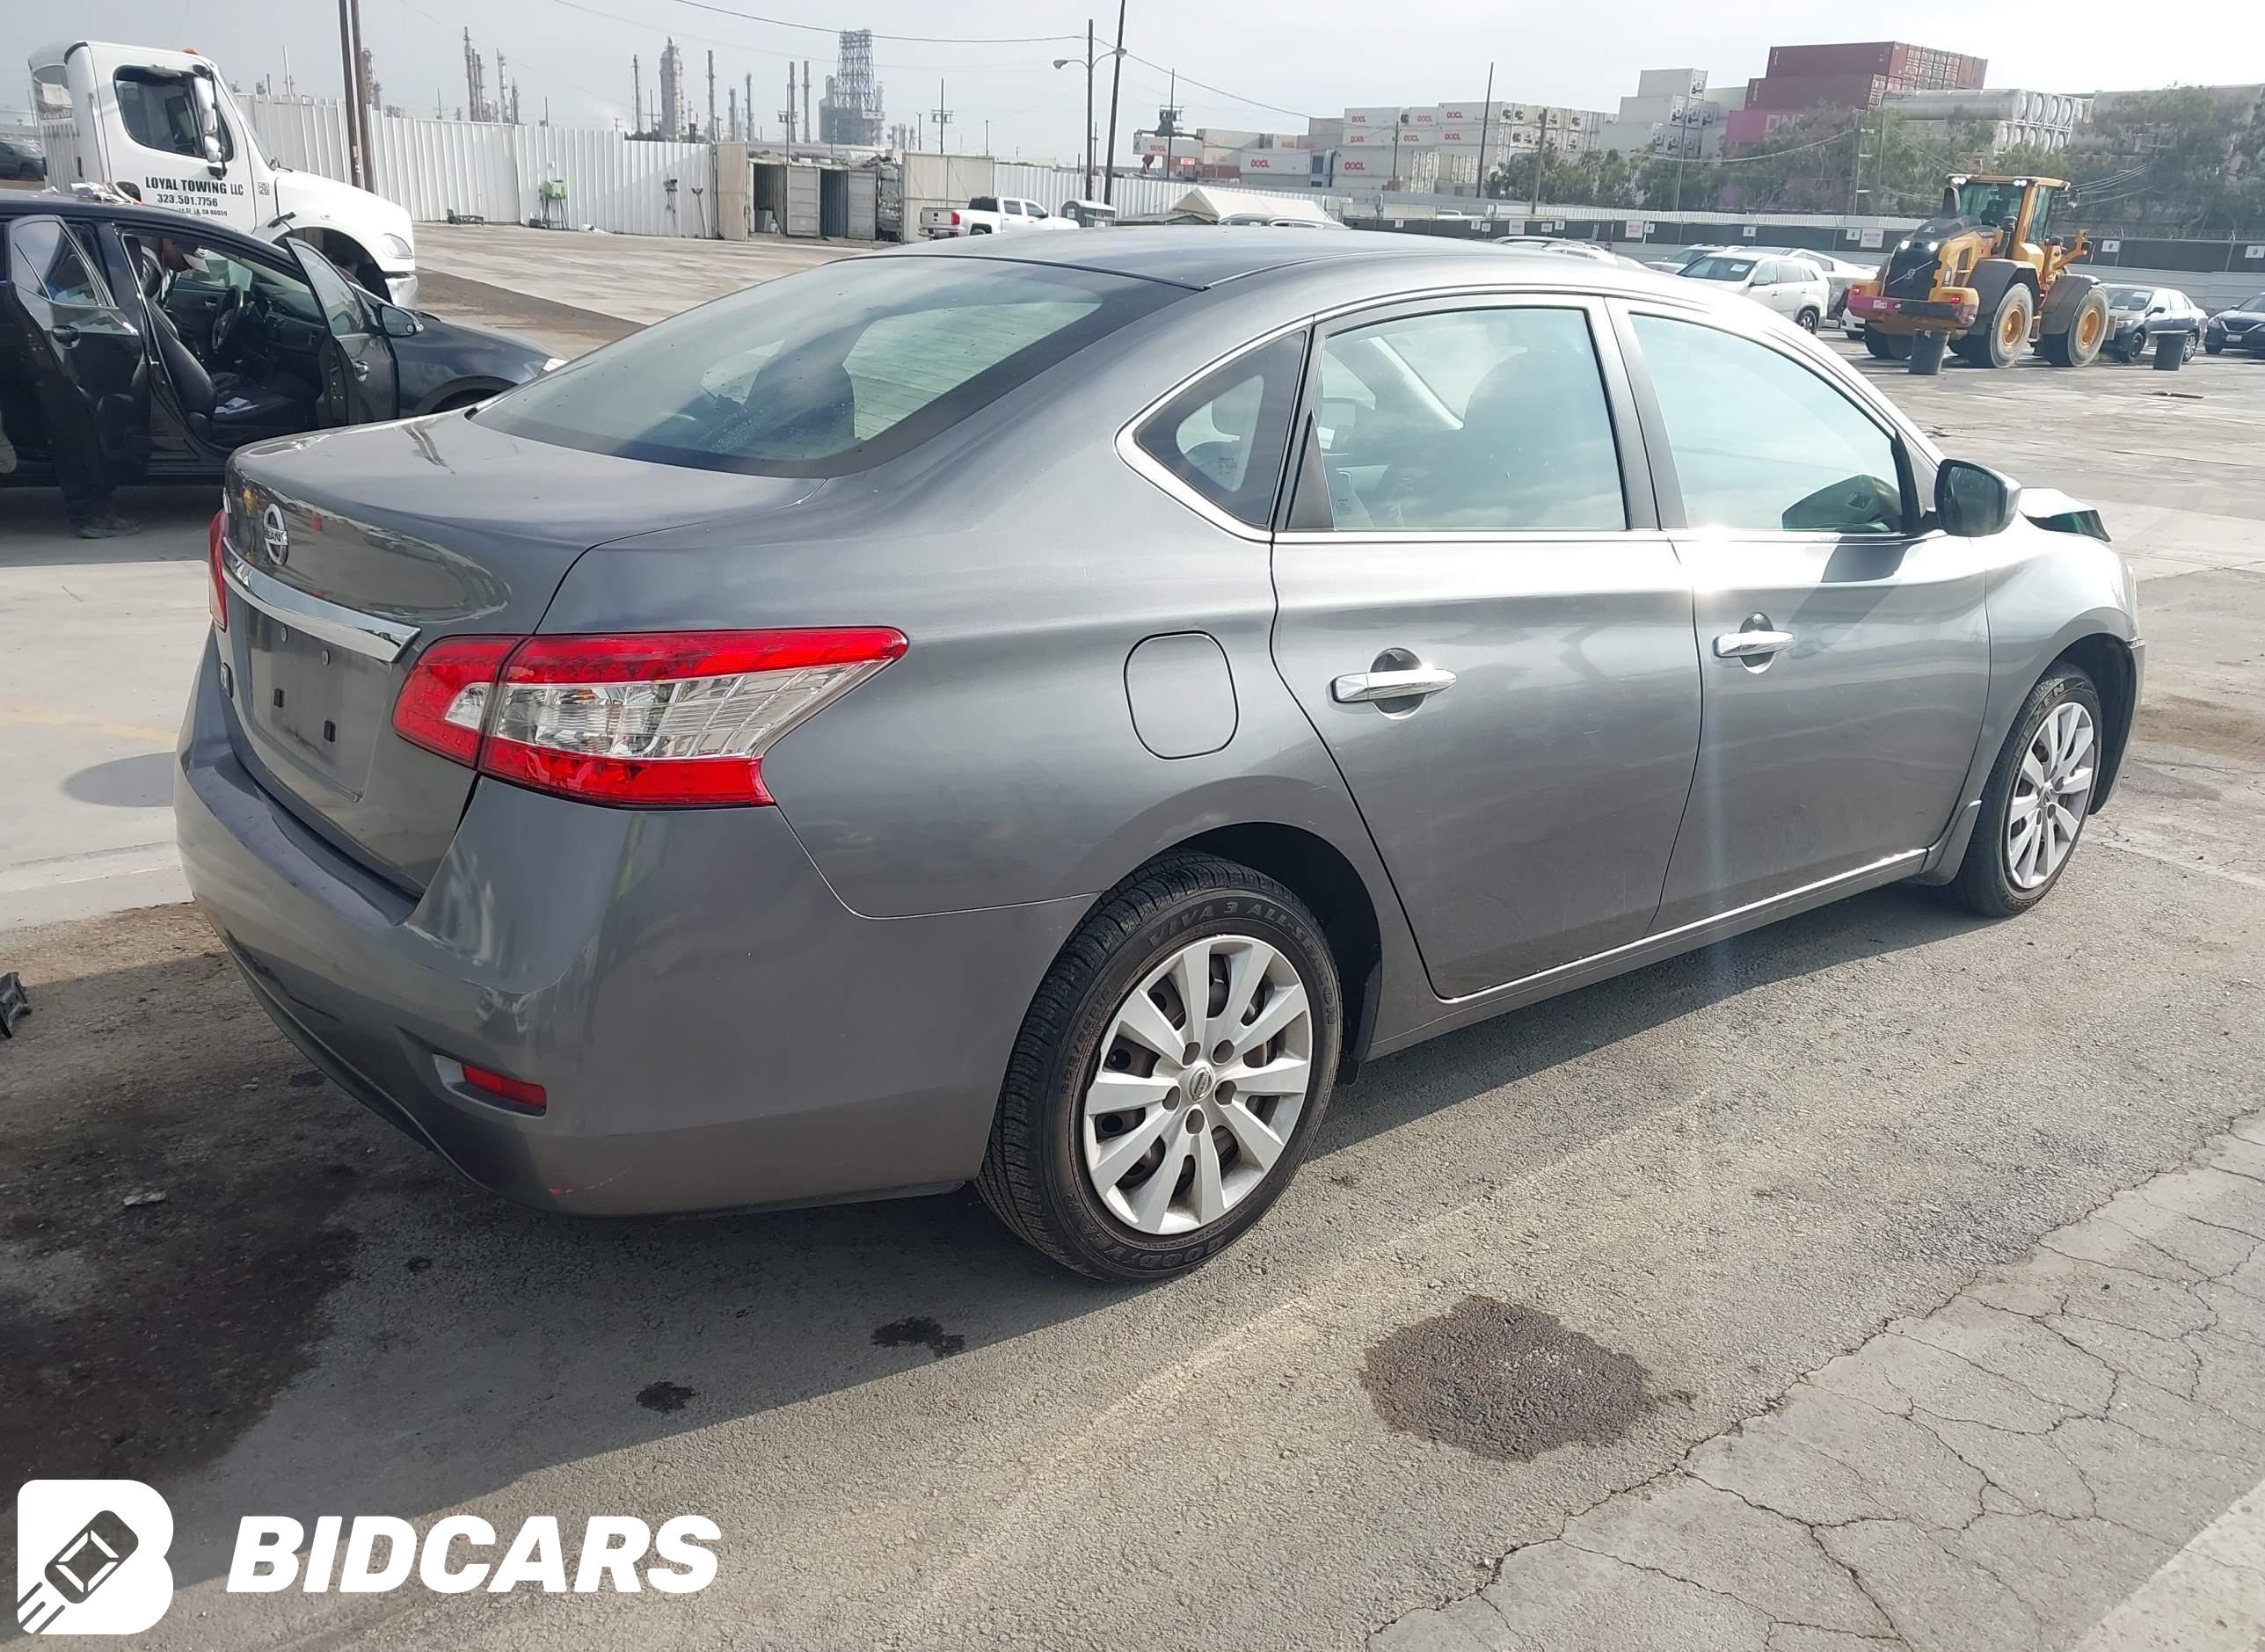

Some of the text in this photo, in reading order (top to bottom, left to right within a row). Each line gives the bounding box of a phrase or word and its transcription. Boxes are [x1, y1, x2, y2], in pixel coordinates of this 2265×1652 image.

[1250, 158, 1270, 169] OOCL
[1344, 161, 1365, 171] OOCL
[145, 177, 244, 196] LOYAL TOWING LLC
[157, 193, 218, 207] 323.501.7756
[1147, 901, 1336, 1026] VIVA 3 ALL-SEASON
[1065, 1193, 1227, 1269] GOODYEAR
